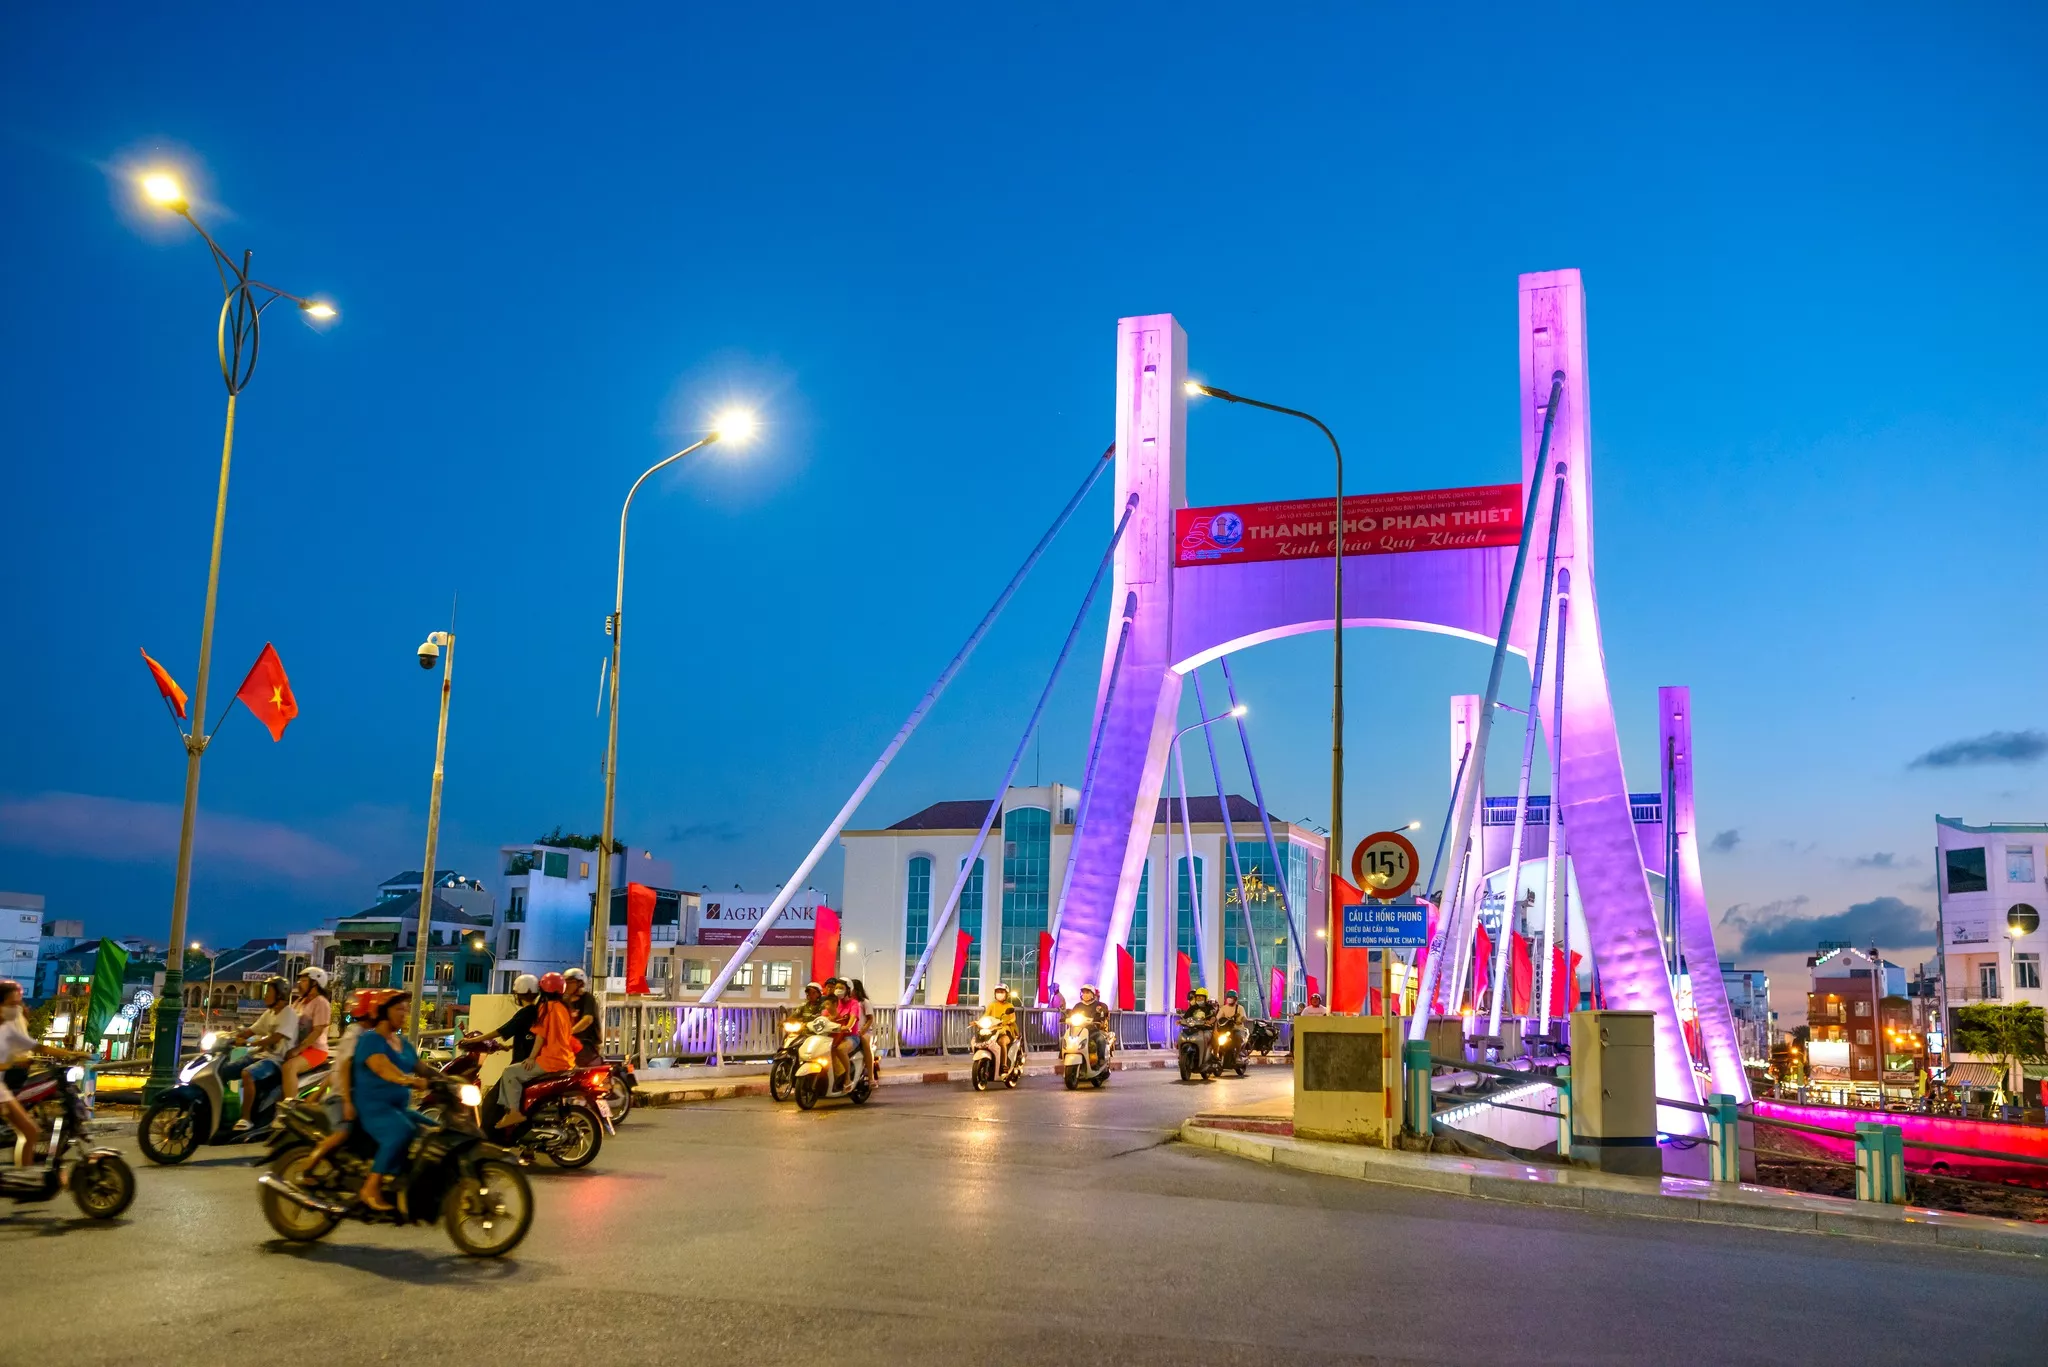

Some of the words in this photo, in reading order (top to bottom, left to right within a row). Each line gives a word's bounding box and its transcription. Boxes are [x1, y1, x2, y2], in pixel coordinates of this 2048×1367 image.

[1383, 514, 1445, 530] PHAN
[1275, 540, 1319, 555] Kính
[1380, 534, 1415, 551] Quý
[1422, 529, 1487, 547] Khách
[723, 907, 815, 920] AGRIANK
[1364, 910, 1374, 922] LÊ
[1397, 911, 1422, 922] PHONG
